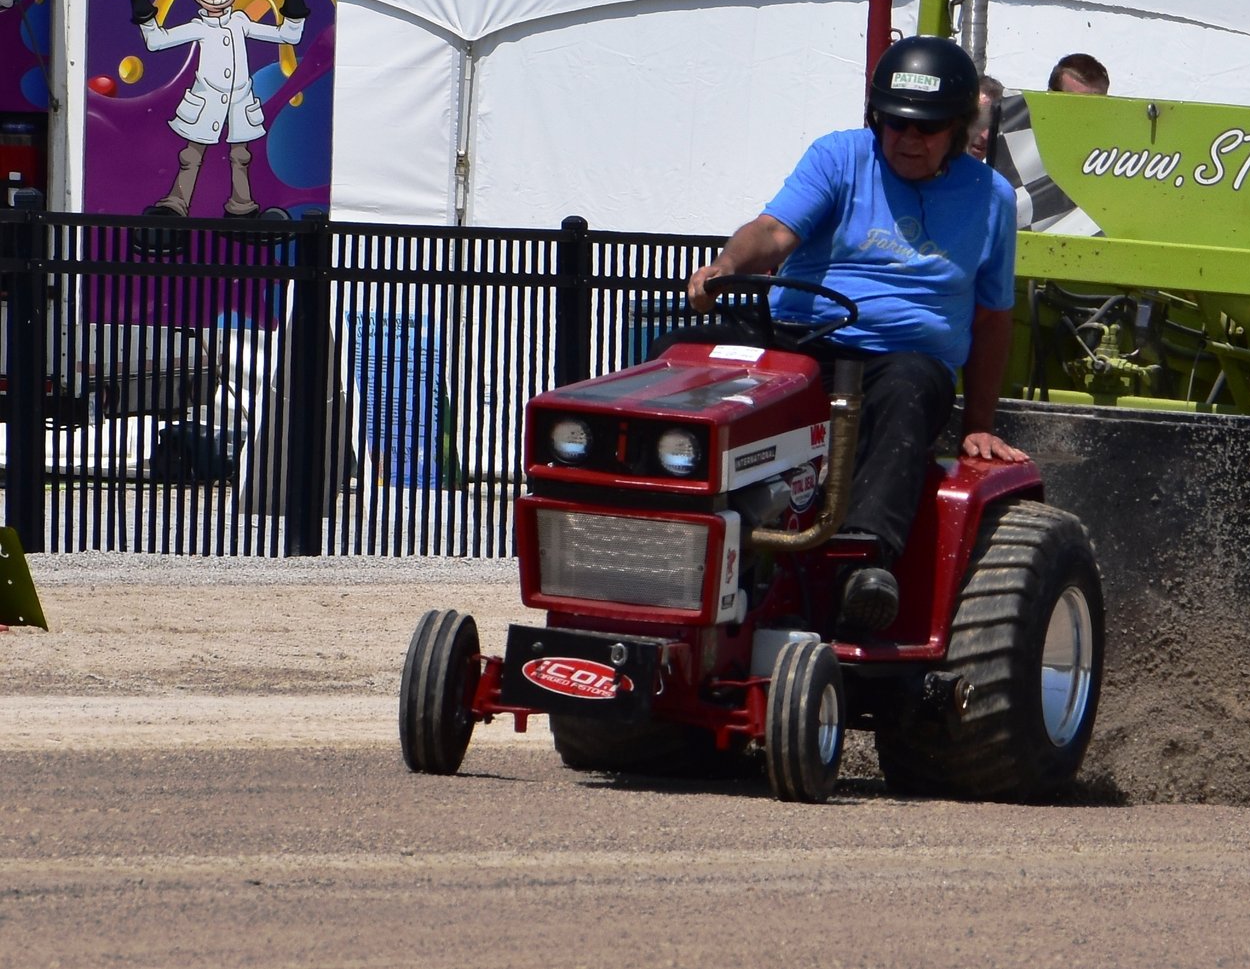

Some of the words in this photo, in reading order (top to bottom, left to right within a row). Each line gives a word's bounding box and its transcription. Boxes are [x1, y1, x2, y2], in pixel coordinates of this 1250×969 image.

[893, 73, 940, 88] PATIENT
[734, 448, 776, 469] INTERNATIONAL
[530, 671, 570, 686] FORGED
